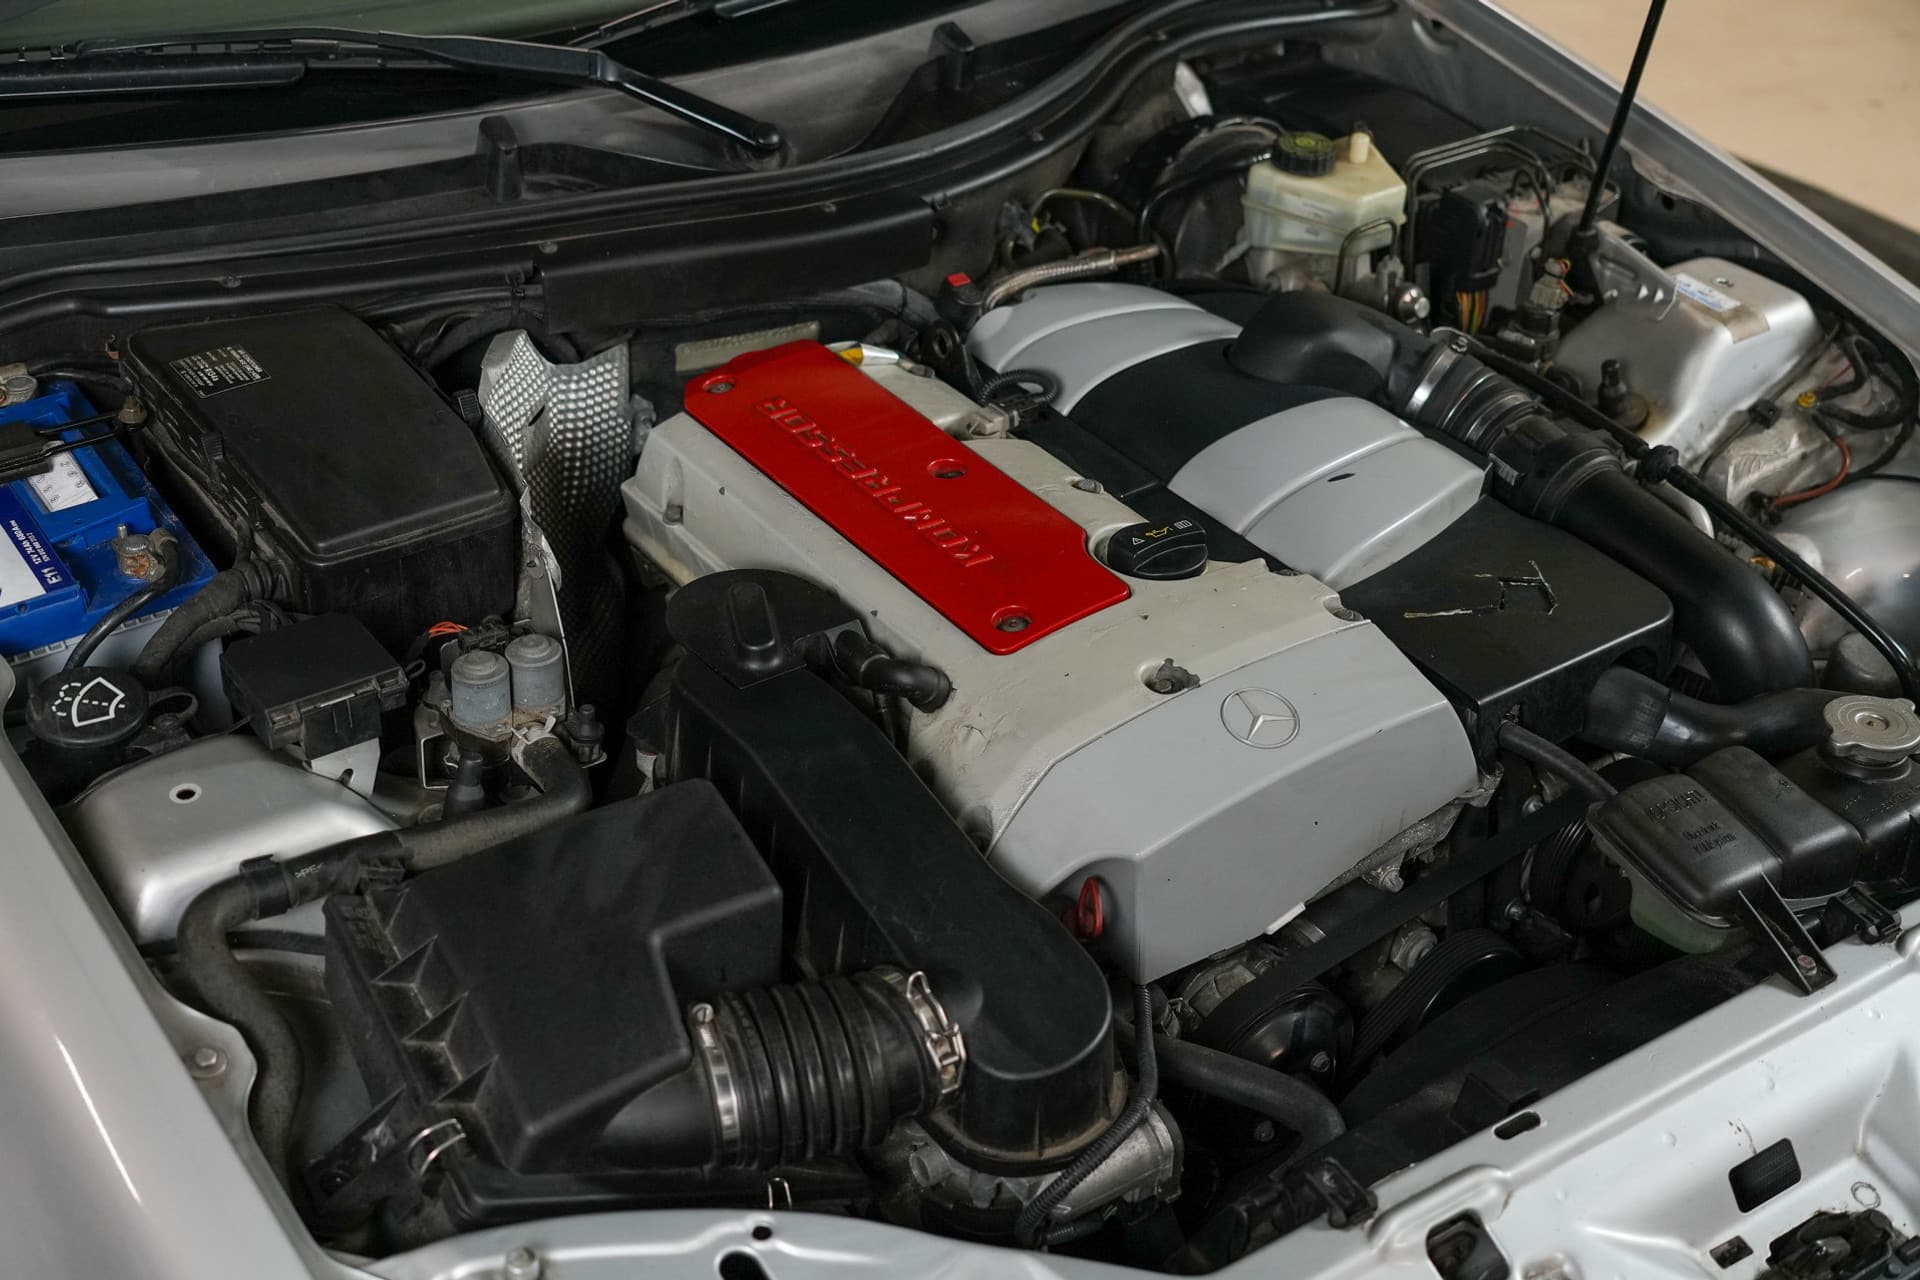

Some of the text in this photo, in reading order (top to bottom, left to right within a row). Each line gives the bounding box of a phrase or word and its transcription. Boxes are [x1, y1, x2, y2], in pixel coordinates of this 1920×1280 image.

[755, 396, 994, 568] KOMPRESSOR
[30, 554, 42, 565] 12V
[41, 566, 63, 584] E11
